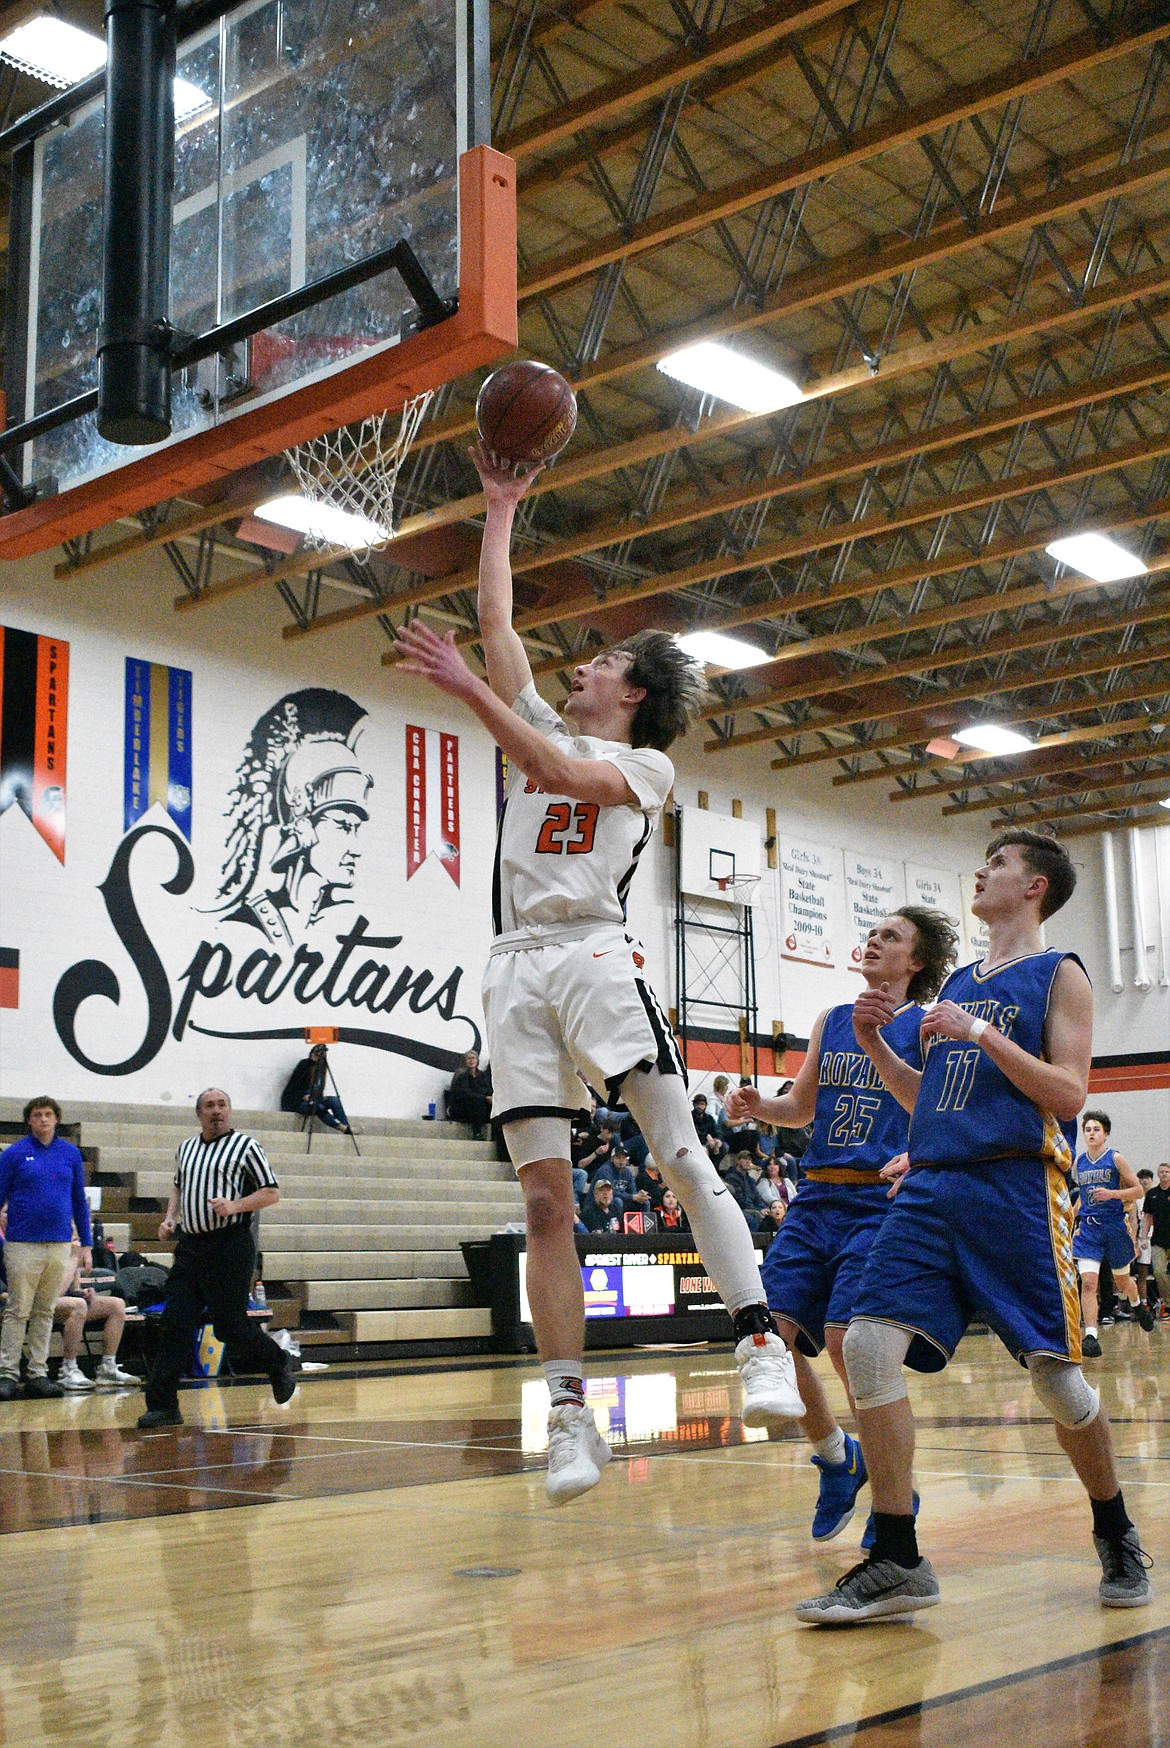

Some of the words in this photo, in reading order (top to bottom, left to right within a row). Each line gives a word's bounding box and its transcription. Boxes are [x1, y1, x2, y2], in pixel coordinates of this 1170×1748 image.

[47, 645, 58, 771] SPARTANS
[176, 675, 185, 752] TIGERS
[132, 664, 143, 810] TIMBERLAKE
[446, 740, 455, 833] PANTHERS
[413, 774, 421, 863] CHARTER
[535, 802, 600, 855] 23
[790, 848, 810, 863] Girls
[797, 877, 816, 892] State
[856, 864, 872, 878] Boys
[915, 879, 932, 892] Girls
[788, 888, 825, 908] Basketball
[788, 902, 828, 921] Champions
[861, 891, 879, 904] State
[920, 893, 936, 905] State
[793, 919, 824, 937] 2009-10
[53, 824, 481, 1077] Spartans
[818, 1051, 890, 1091] ROYAL
[935, 1049, 981, 1112] 11
[827, 1093, 882, 1147] 25
[680, 1276, 702, 1294] LONE
